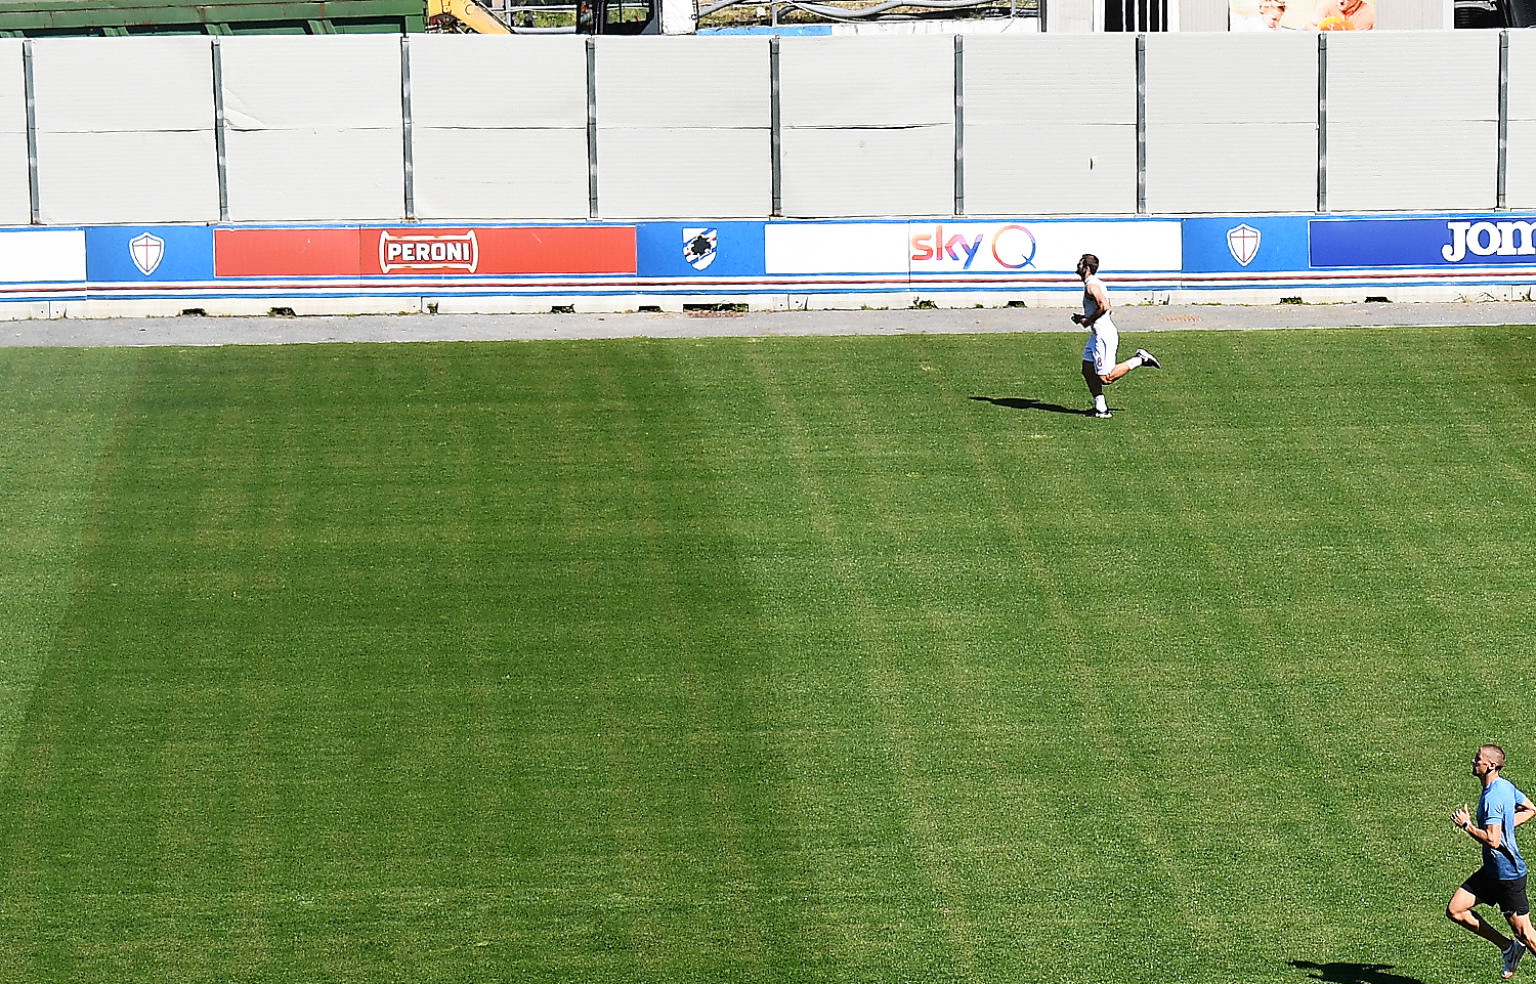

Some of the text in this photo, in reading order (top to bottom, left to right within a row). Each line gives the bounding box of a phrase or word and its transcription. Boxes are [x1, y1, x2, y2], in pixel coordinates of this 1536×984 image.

[387, 242, 470, 261] PERONI
[911, 224, 1037, 269] sky Q
